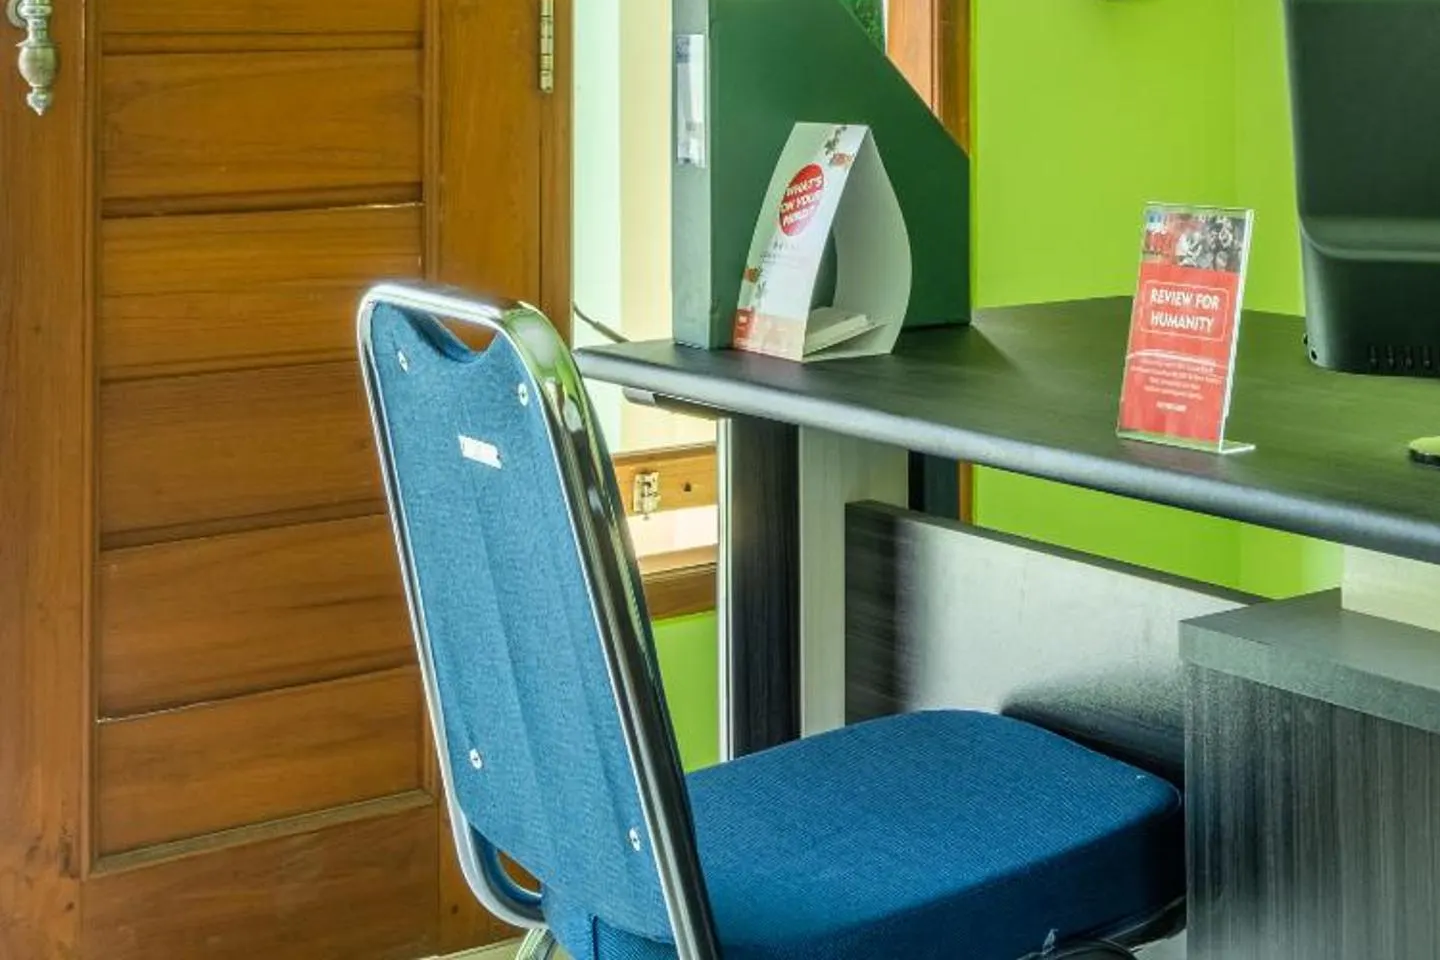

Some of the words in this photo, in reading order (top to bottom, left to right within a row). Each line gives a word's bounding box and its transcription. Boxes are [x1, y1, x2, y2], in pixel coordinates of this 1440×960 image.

[1151, 288, 1193, 307] REVIEW
[1196, 293, 1221, 312] FOR
[1151, 312, 1215, 333] HUMANITY
